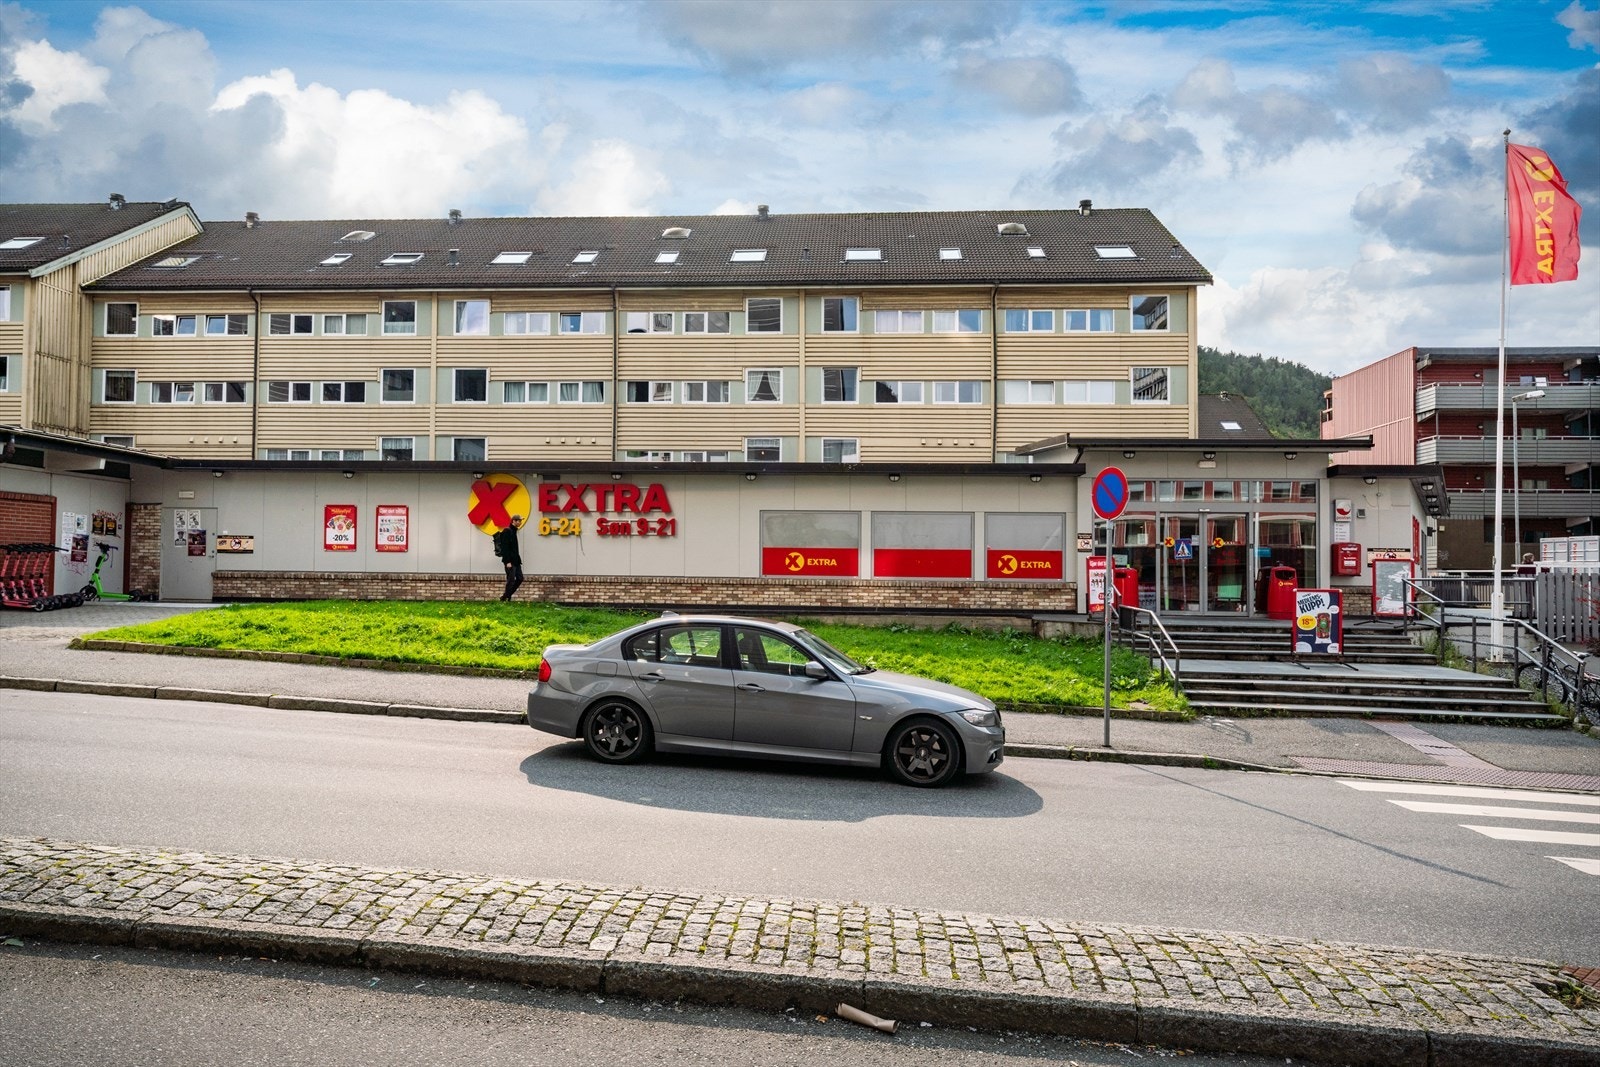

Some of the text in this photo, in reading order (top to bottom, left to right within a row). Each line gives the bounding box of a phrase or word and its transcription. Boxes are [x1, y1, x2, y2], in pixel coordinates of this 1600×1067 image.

[538, 483, 672, 514] EXTRA
[538, 517, 676, 537] 6-24 Søn 9-21
[332, 534, 349, 542] -20%
[807, 558, 838, 566] EXTRA
[1020, 561, 1051, 569] EXTRA
[1299, 598, 1325, 614] KUPP!
